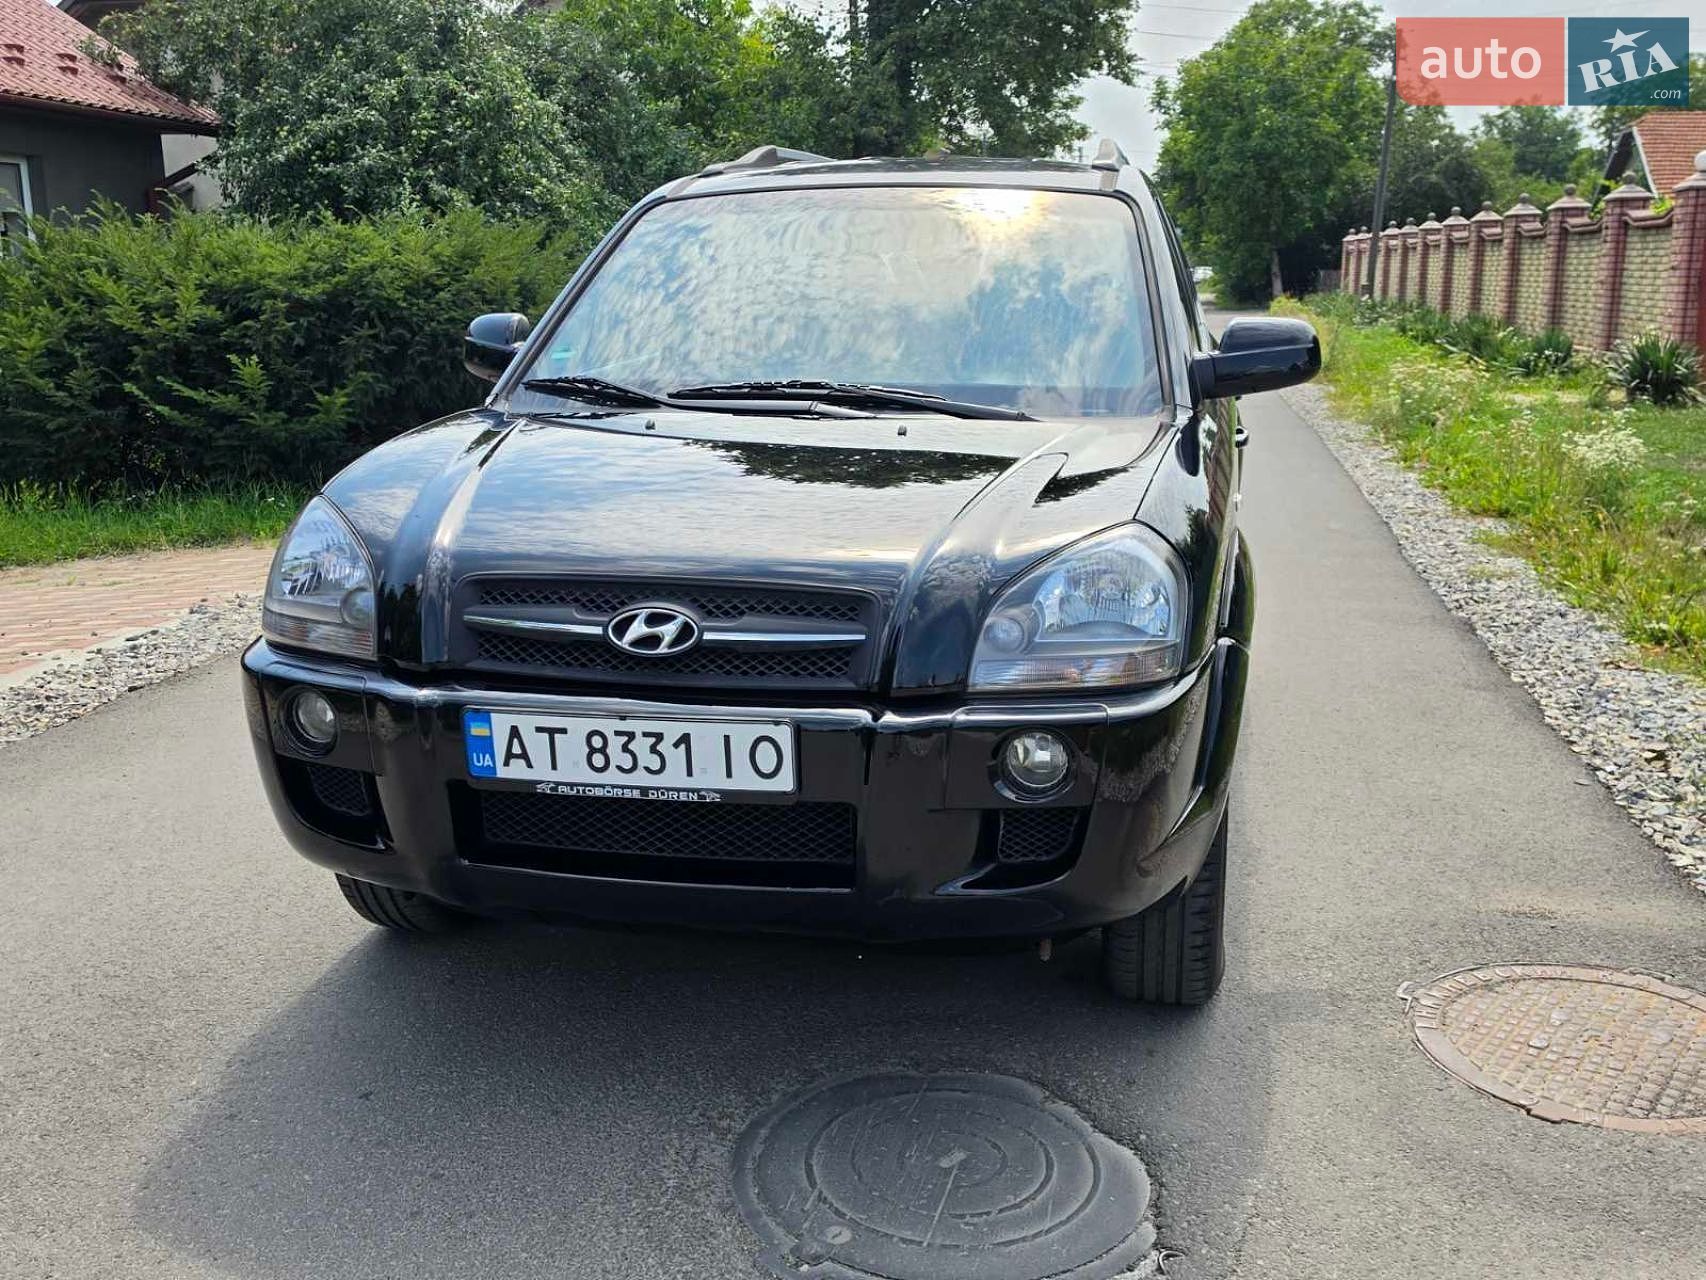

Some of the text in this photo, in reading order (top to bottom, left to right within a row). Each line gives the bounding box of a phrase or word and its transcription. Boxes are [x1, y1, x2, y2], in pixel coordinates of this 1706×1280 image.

[472, 752, 494, 768] UA
[502, 724, 784, 780] AT 8331 IO
[557, 785, 698, 800] AUTOBÖRSE DÜREN
